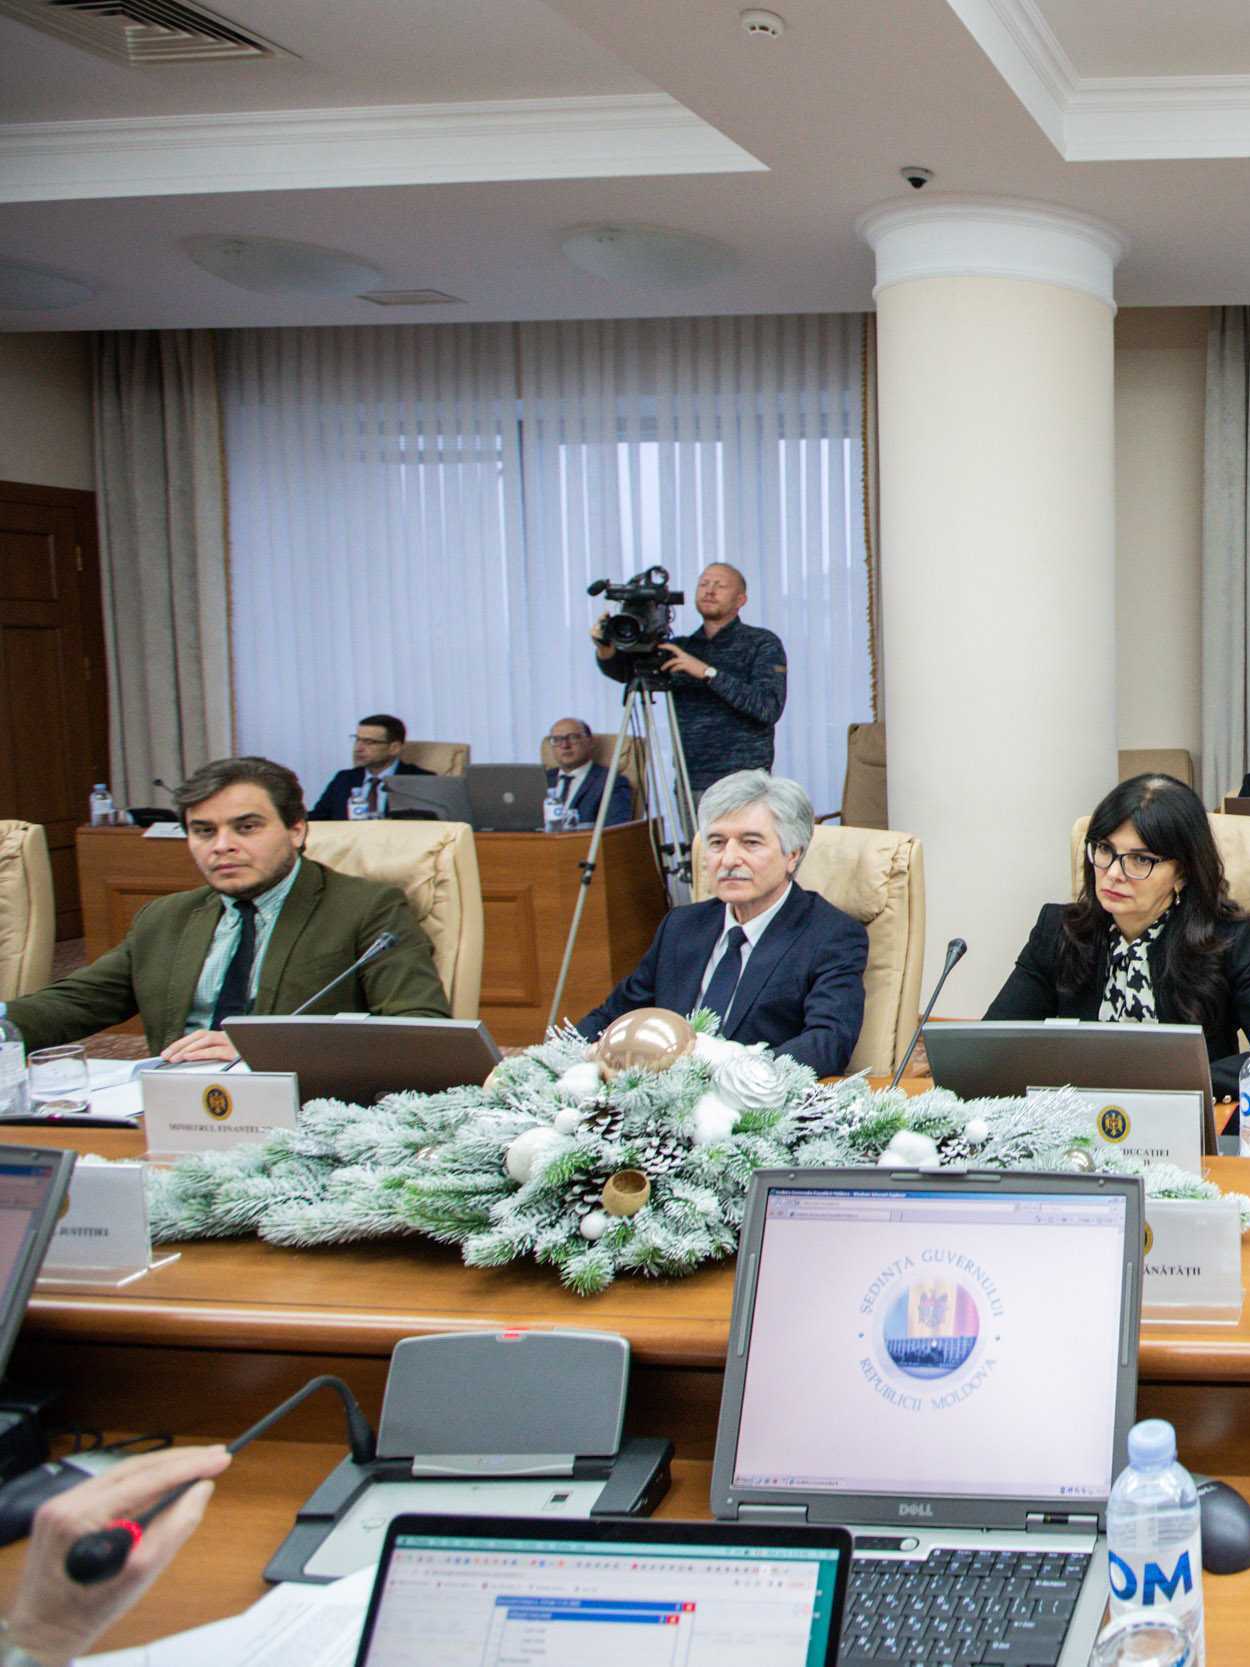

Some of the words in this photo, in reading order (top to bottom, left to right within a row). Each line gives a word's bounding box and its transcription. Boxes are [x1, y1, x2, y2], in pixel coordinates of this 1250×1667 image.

[930, 1358, 997, 1410] MOLDOVA
[899, 1503, 933, 1517] DELL
[1108, 1551, 1193, 1606] OM
